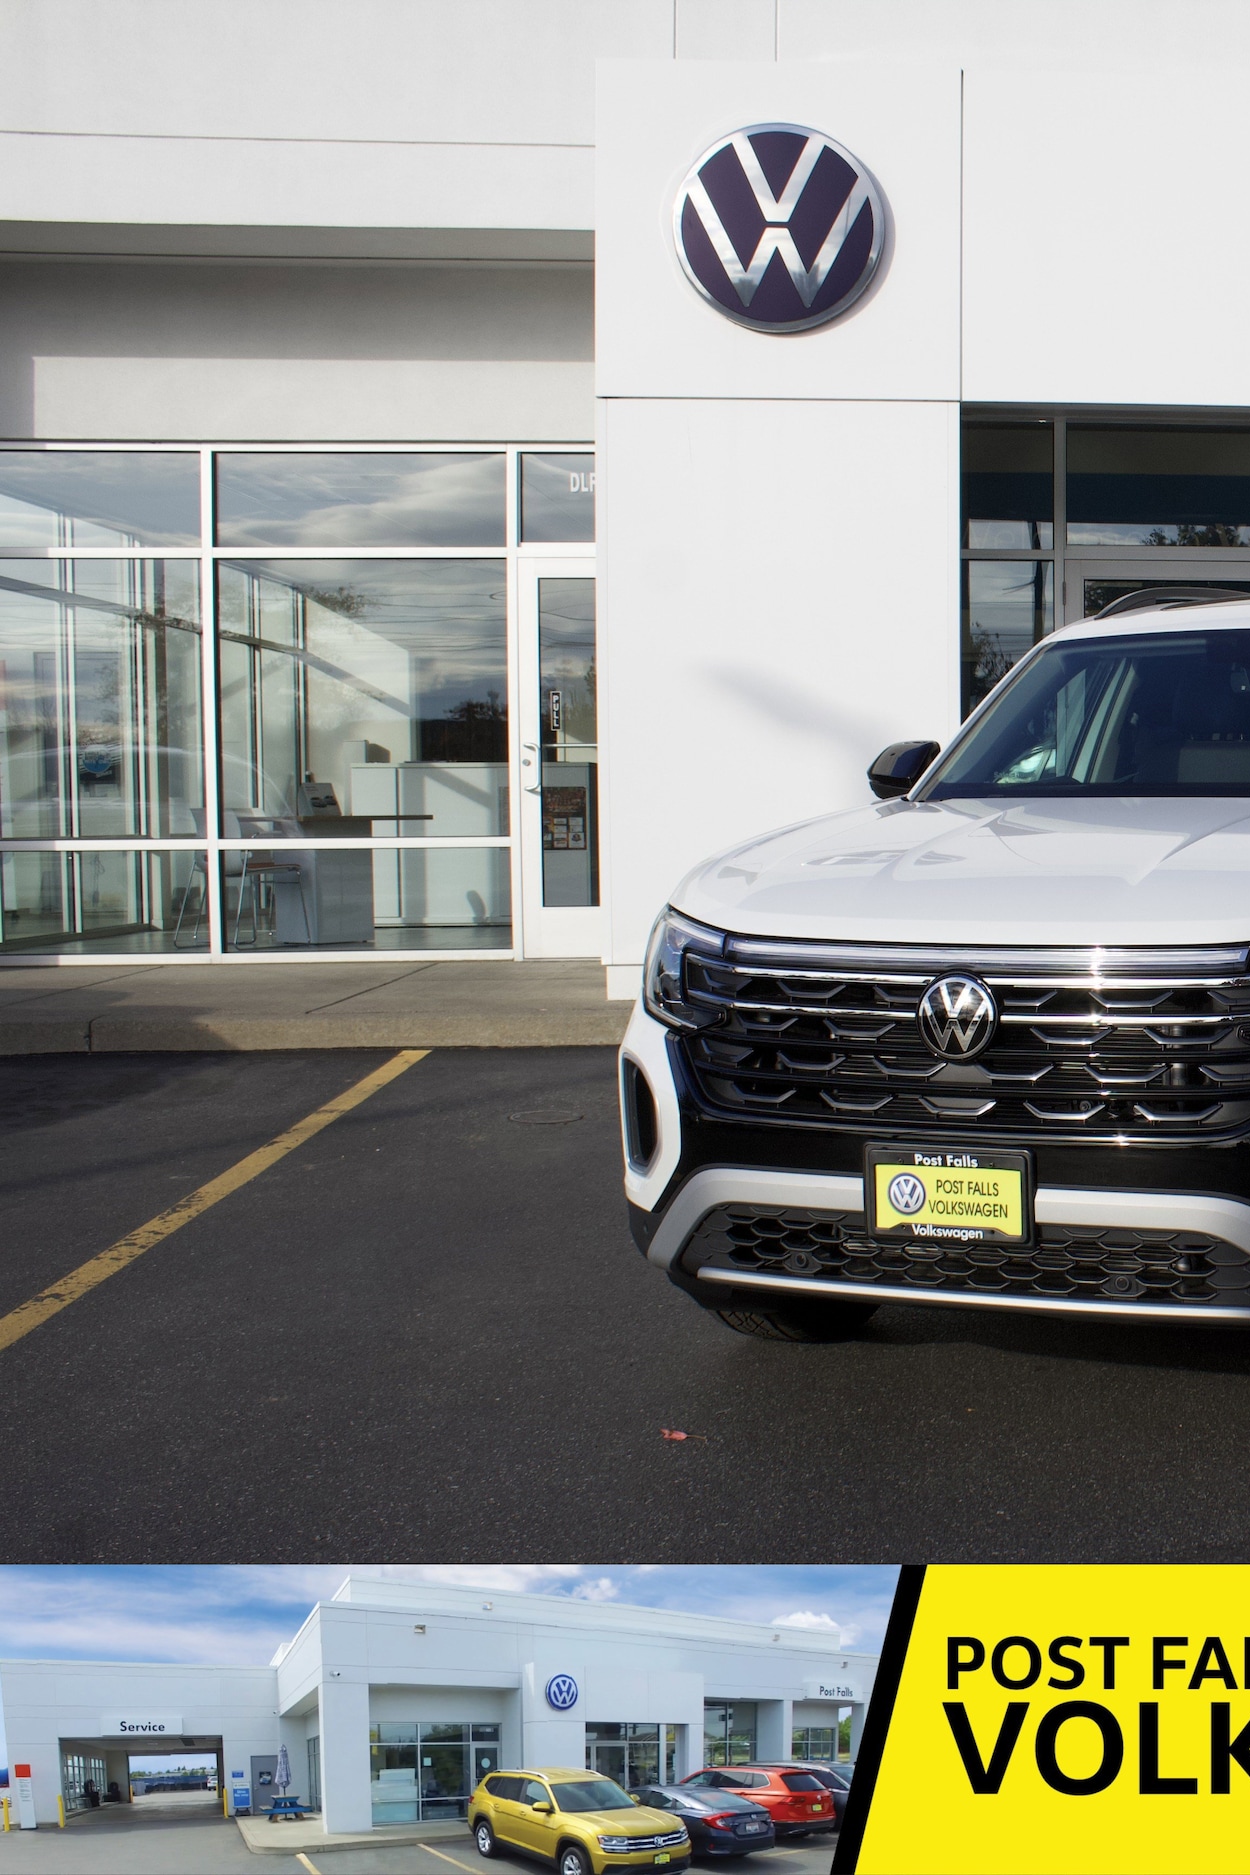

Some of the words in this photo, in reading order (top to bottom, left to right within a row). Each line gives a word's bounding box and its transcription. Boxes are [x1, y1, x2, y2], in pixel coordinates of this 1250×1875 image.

[679, 127, 874, 309] VW
[552, 694, 560, 727] PULL
[922, 979, 991, 1053] VW
[914, 1153, 942, 1167] Post
[946, 1154, 979, 1168] Falls
[890, 1176, 924, 1213] VW
[936, 1179, 964, 1195] POST
[967, 1181, 999, 1197] FALLS
[928, 1200, 1008, 1219] VOLKSWAGEN
[911, 1223, 984, 1242] Volkswagen
